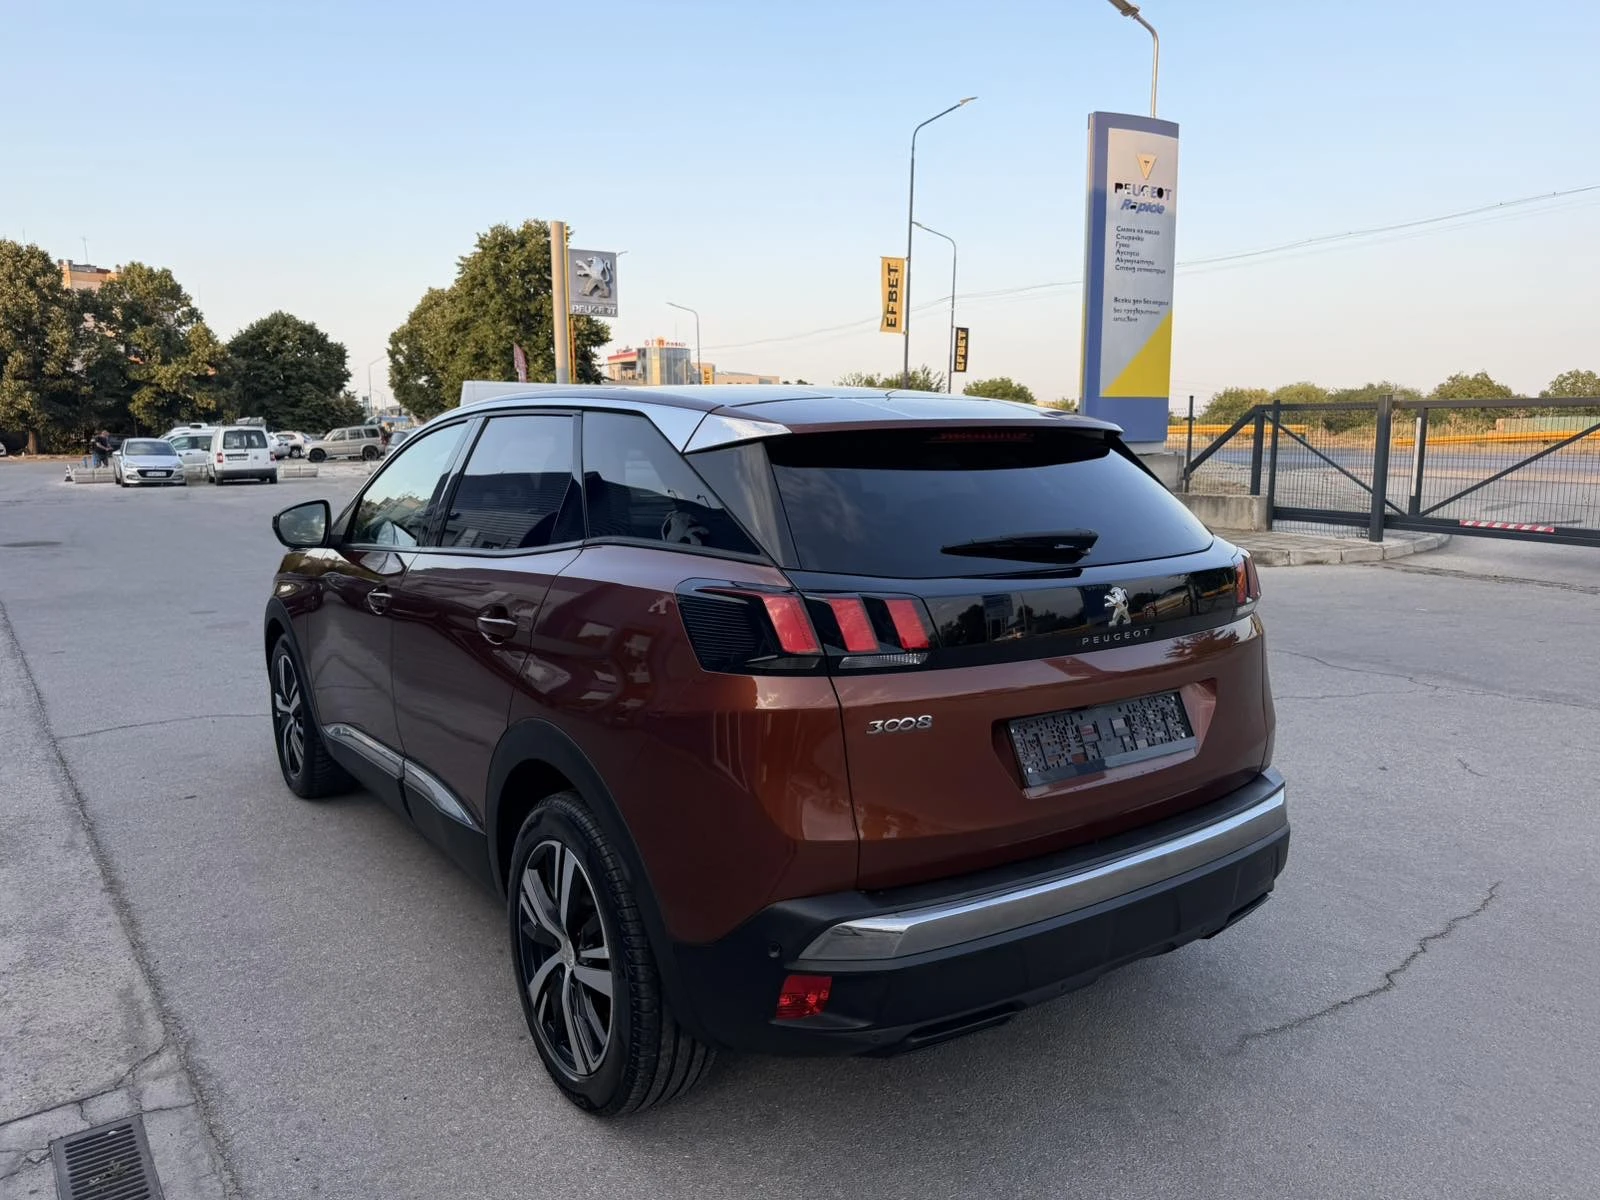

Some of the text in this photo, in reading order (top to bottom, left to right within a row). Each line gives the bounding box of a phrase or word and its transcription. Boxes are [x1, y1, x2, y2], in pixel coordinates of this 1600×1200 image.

[1114, 182, 1172, 201] PEUGEOT
[1120, 198, 1165, 214] Rapide
[886, 263, 899, 328] EFBET
[572, 303, 617, 316] PEUGEOT
[956, 330, 967, 371] EFBET
[1081, 627, 1152, 646] PEUGEOT
[865, 714, 933, 734] 3008
